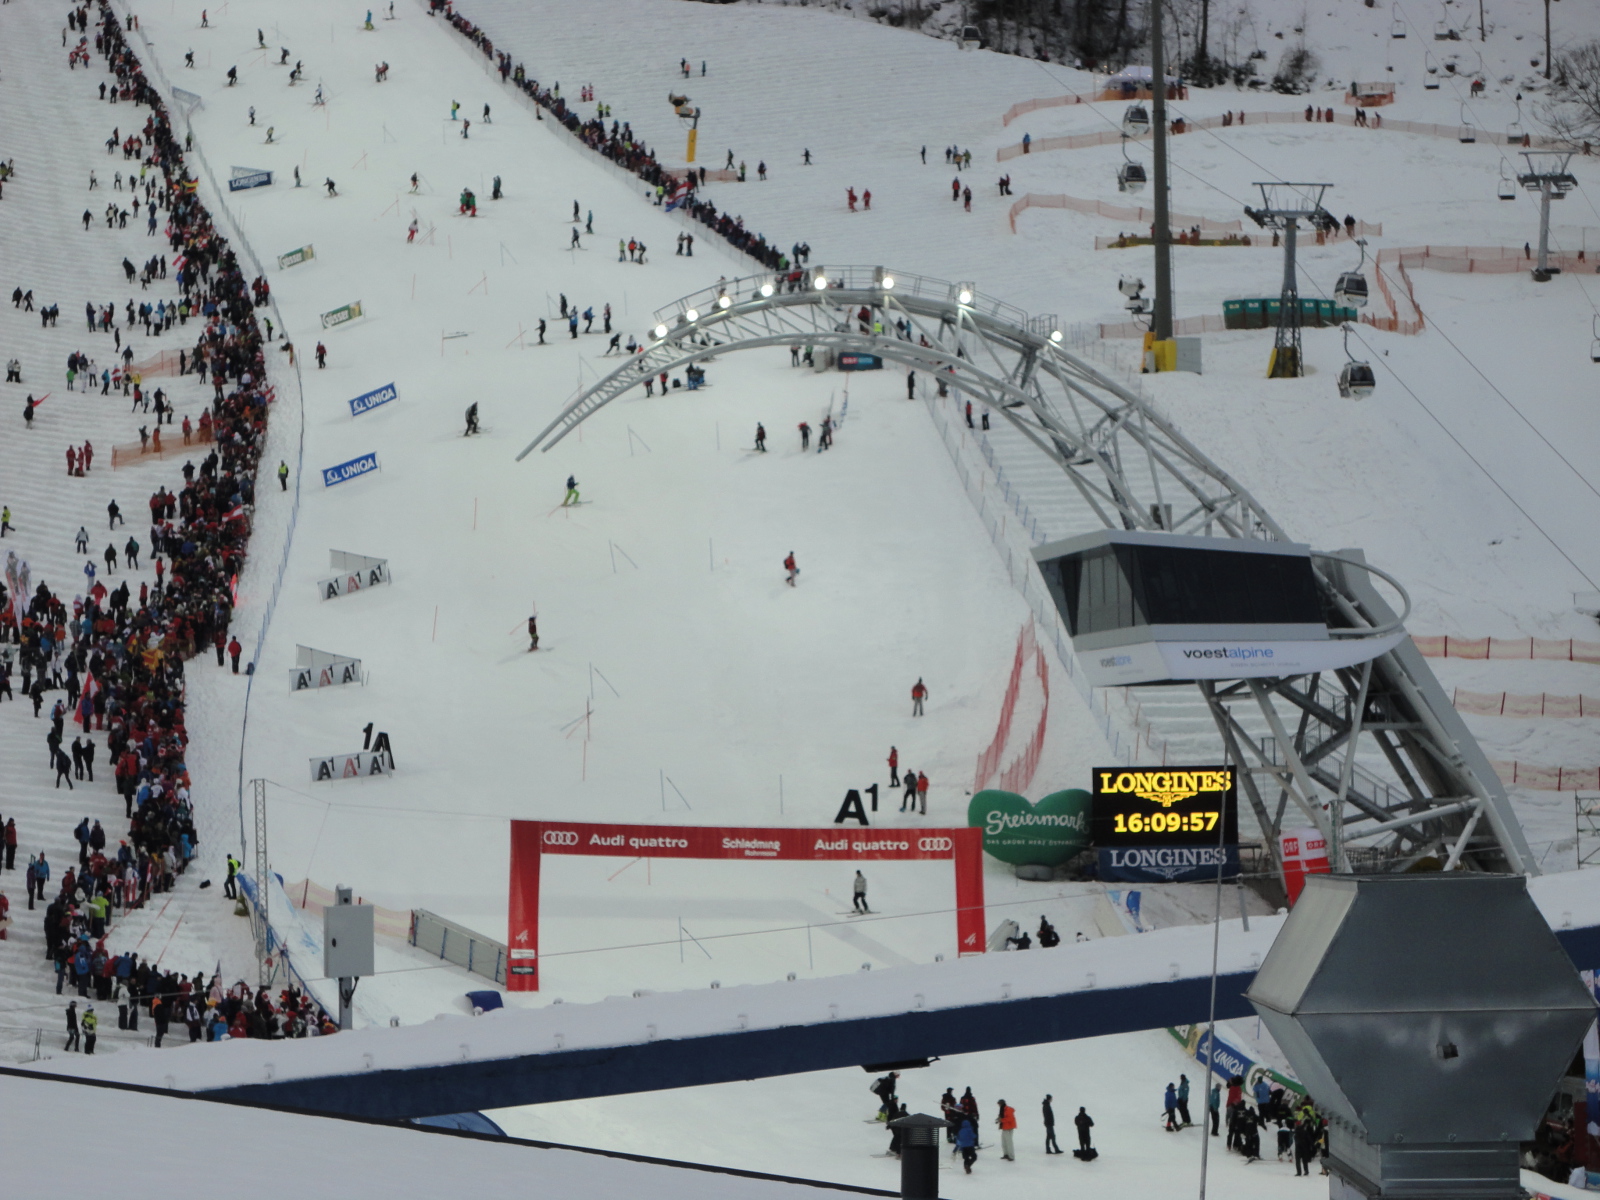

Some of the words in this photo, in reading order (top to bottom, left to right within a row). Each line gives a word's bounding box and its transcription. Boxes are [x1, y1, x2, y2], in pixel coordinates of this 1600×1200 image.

[364, 387, 395, 409] UNIQA
[341, 457, 375, 479] UNIQA
[1183, 646, 1274, 660] voestalpine
[1100, 771, 1231, 793] LONGINES
[834, 783, 879, 826] A1
[985, 810, 1090, 835] Steiermark
[1114, 812, 1219, 833] 16:09:57
[589, 833, 625, 847] Audi
[629, 836, 688, 850] quattro
[814, 839, 848, 851] Audi
[852, 839, 909, 853] quattro
[1110, 847, 1227, 867] LONGINES
[1213, 1048, 1245, 1076] UNIQA
